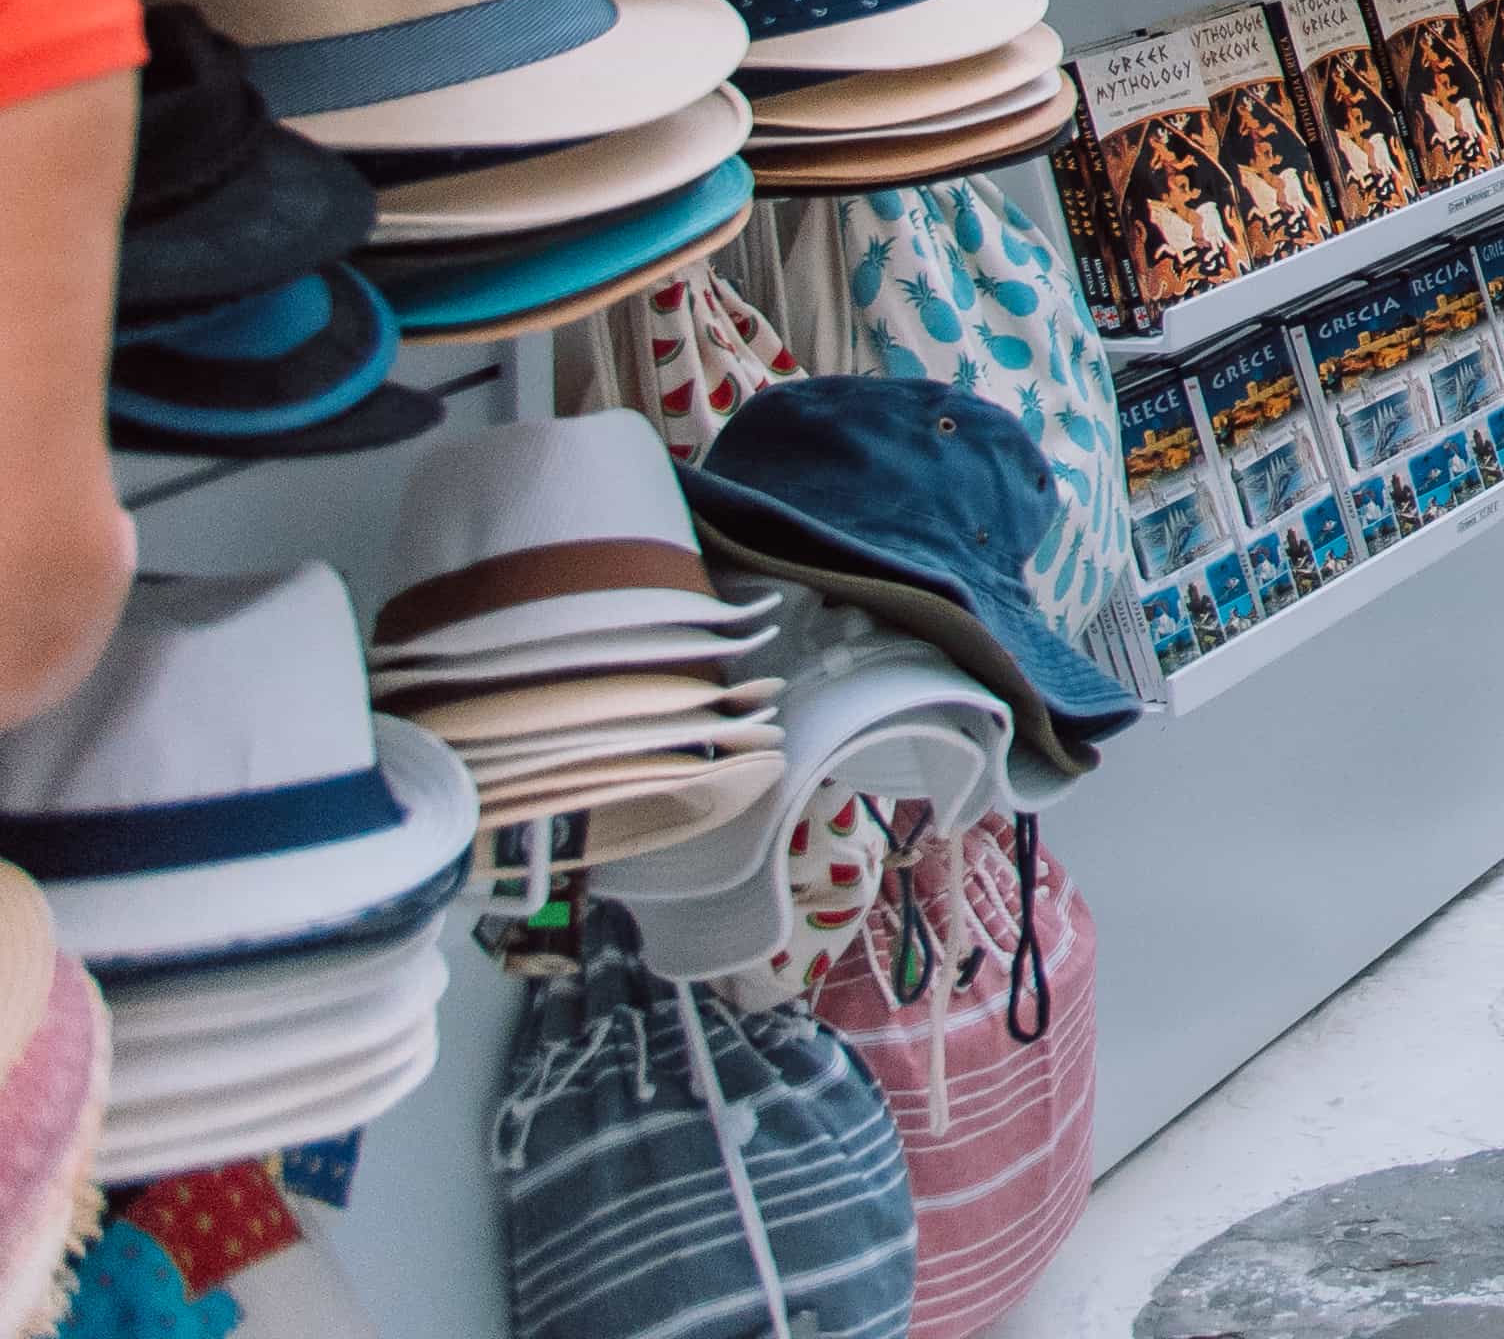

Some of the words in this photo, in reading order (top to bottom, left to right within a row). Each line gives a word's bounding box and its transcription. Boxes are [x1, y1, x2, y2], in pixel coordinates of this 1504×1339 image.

[1096, 58, 1193, 105] MYTHOLOGY
[1107, 44, 1170, 76] GREEK
[1103, 189, 1122, 238] GREEK
[1411, 257, 1470, 297] RECIA
[1317, 294, 1402, 341] GRECIA
[1211, 343, 1277, 392] GRÈCE
[1120, 387, 1181, 430] REECE
